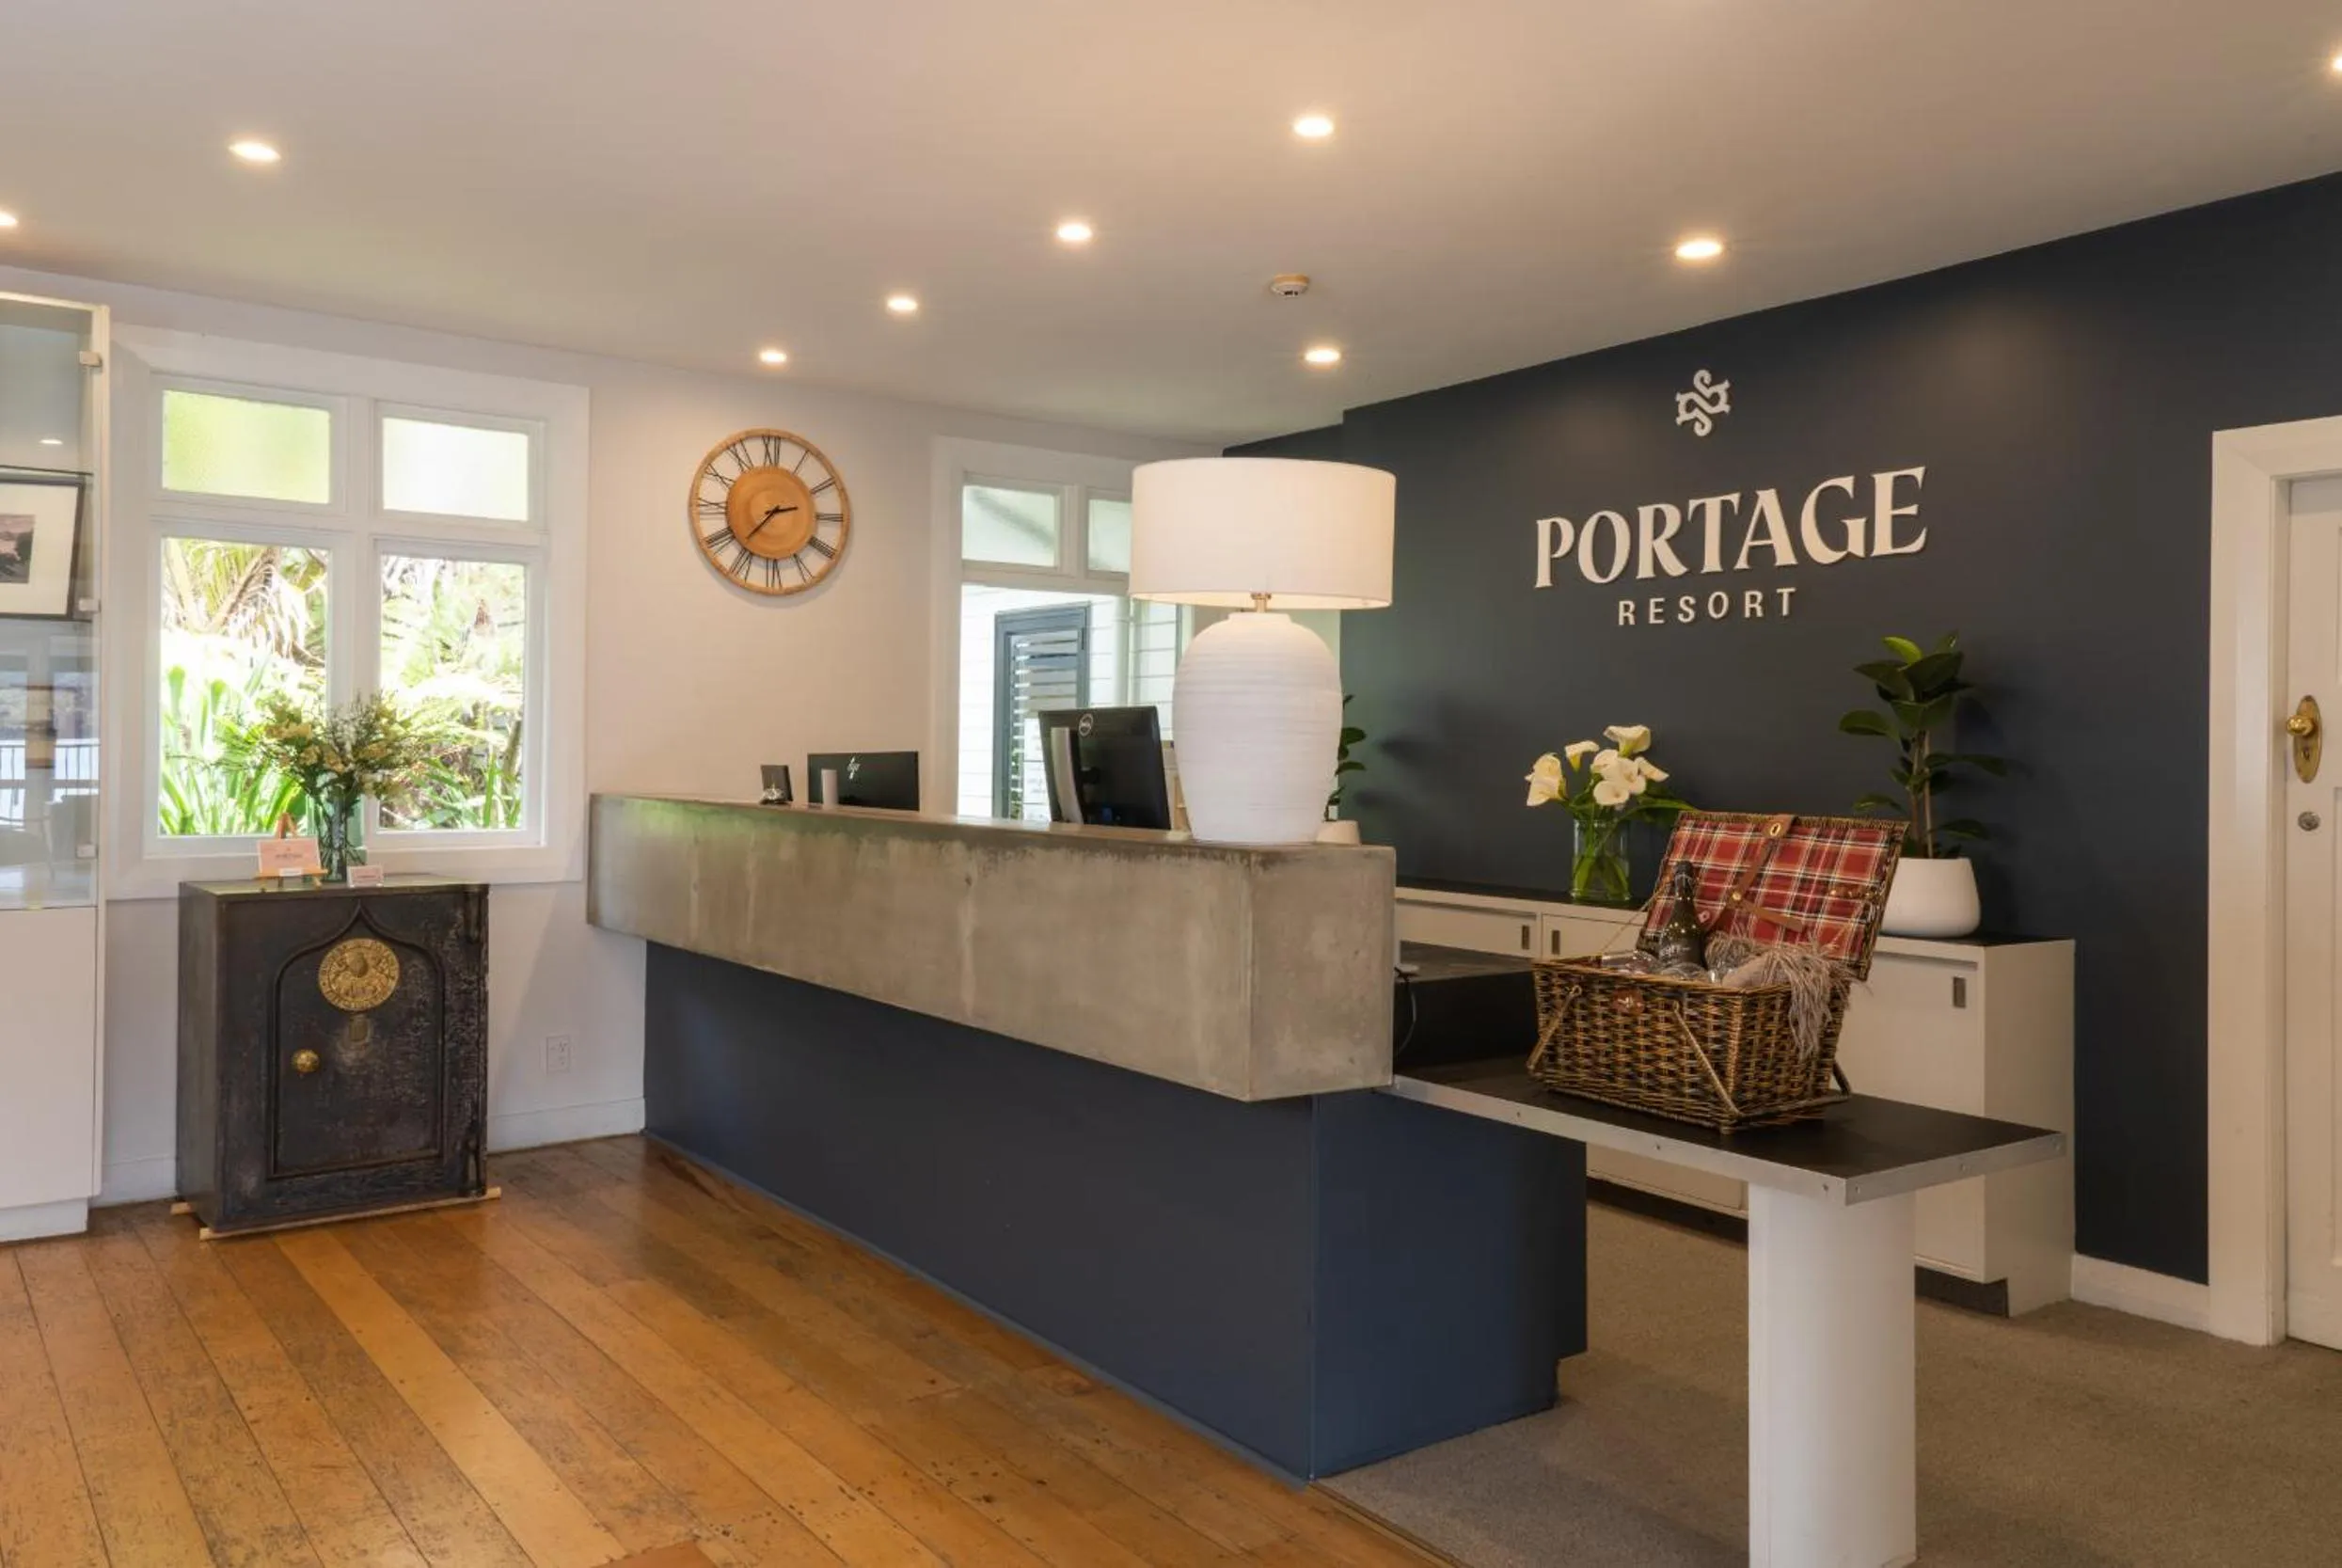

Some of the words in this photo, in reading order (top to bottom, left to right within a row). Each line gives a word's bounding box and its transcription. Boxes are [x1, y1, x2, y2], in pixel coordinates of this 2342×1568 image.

[762, 436, 782, 467] XII
[1534, 466, 1927, 589] PORTAGE
[1618, 587, 1796, 626] RESORT
